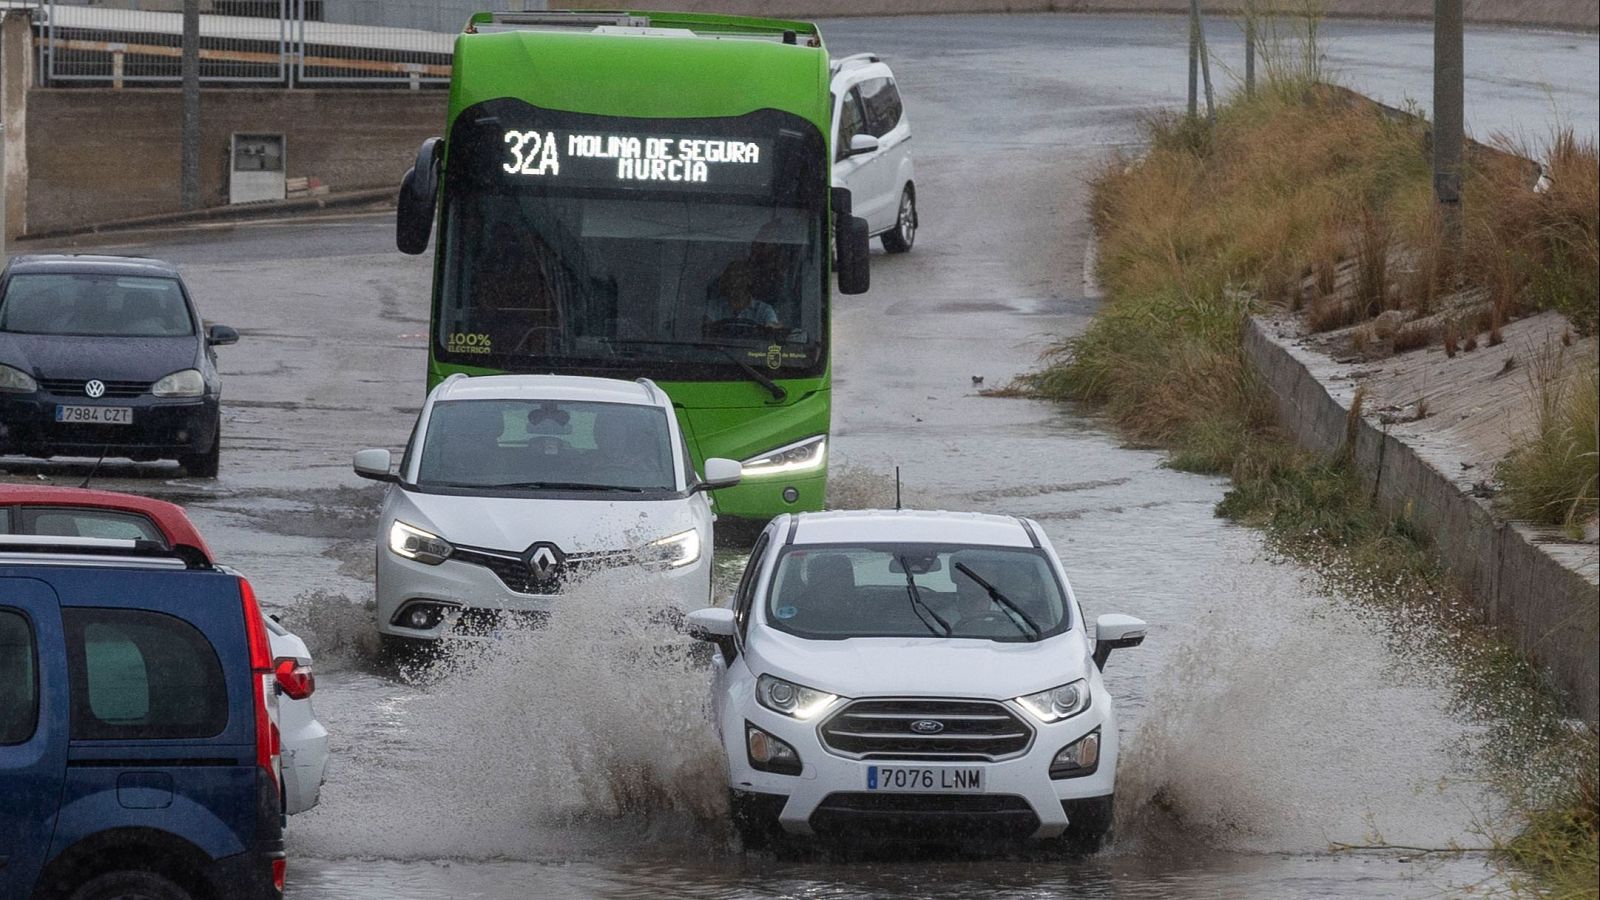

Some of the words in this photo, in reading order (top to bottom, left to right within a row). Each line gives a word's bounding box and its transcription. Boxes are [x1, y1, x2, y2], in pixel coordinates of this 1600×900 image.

[503, 130, 560, 175] 32A
[568, 134, 640, 158] MOLINA
[646, 138, 674, 159] DE
[679, 139, 759, 163] SEGURA
[618, 158, 708, 182] MURCIA
[448, 333, 491, 346] 100%
[66, 407, 98, 420] 7984
[104, 409, 128, 421] CZT
[881, 769, 933, 788] 7076
[942, 769, 980, 788] LNM
